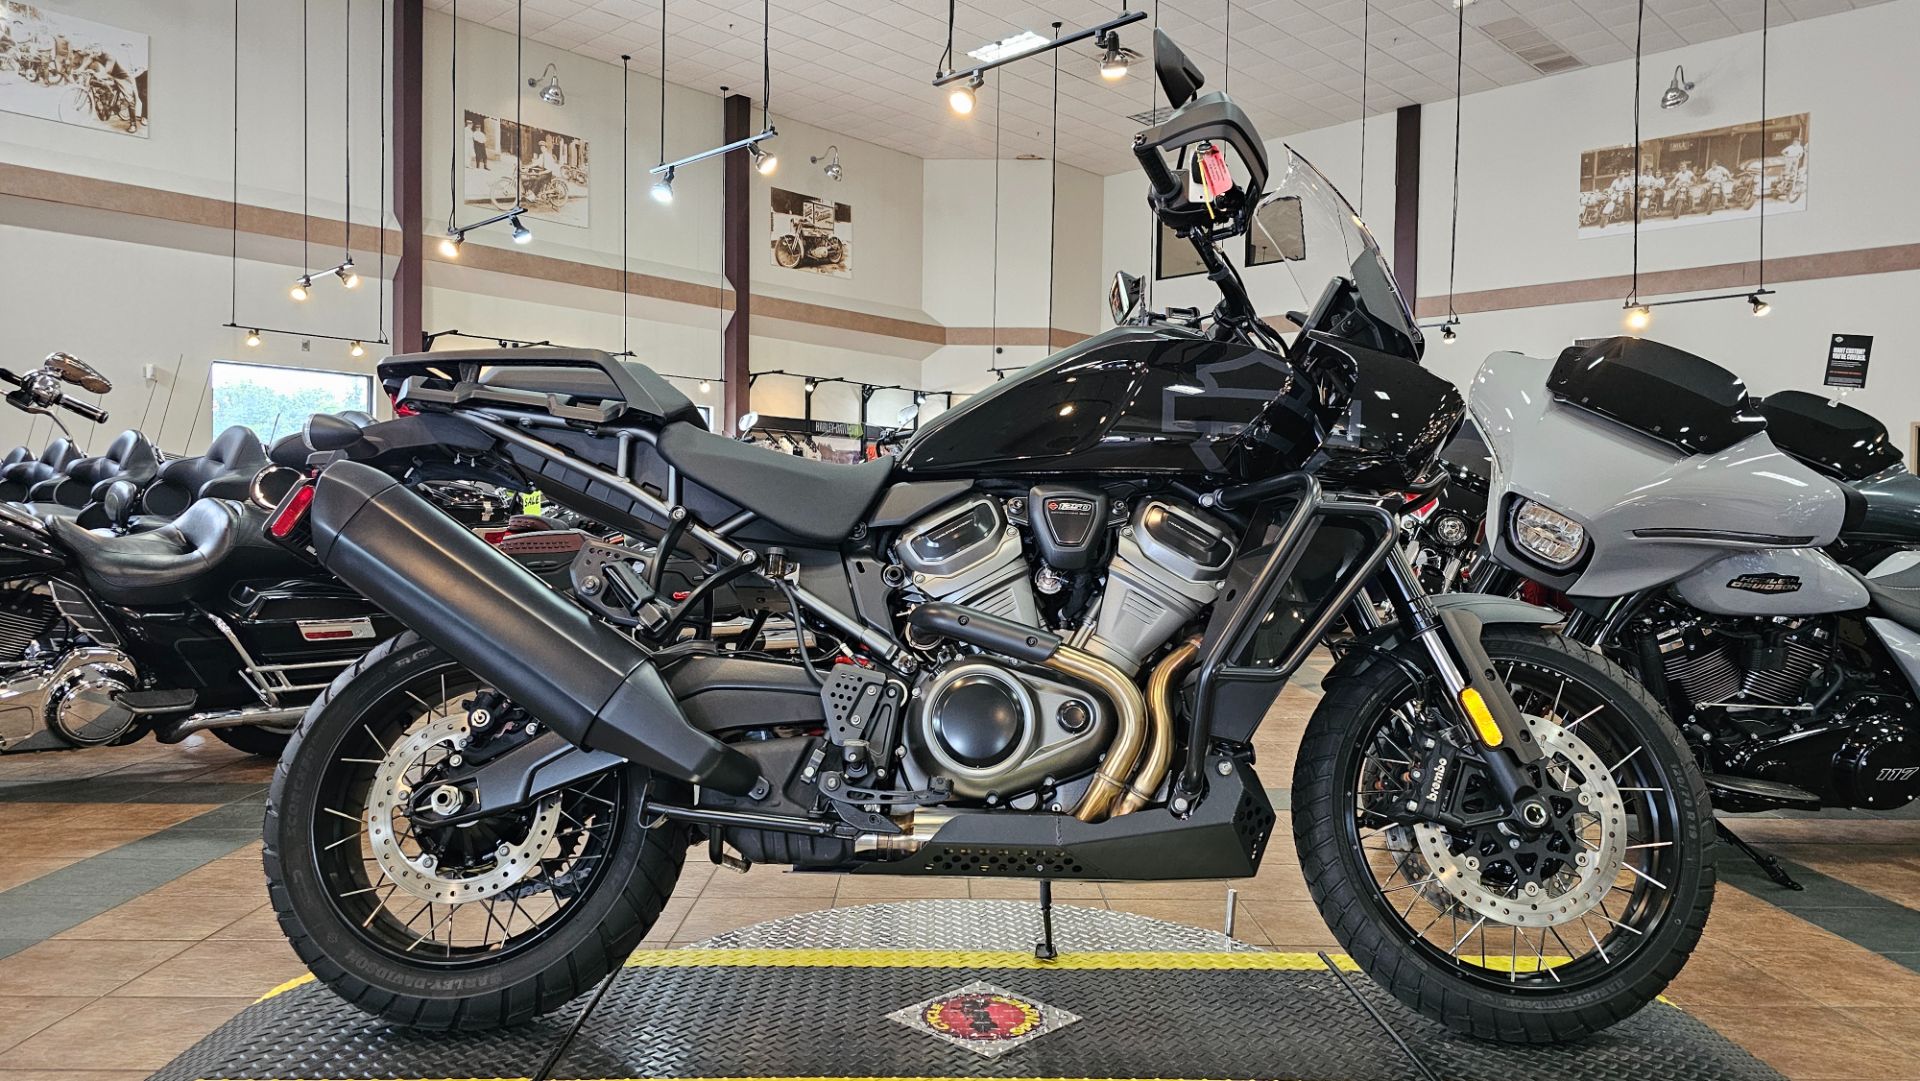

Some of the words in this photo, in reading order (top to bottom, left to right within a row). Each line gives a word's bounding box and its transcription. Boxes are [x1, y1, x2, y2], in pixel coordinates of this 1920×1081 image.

[524, 494, 540, 507] SALE
[1730, 581, 1800, 590] DAVIDSON
[1425, 757, 1447, 802] brembo
[1876, 766, 1920, 781] 117
